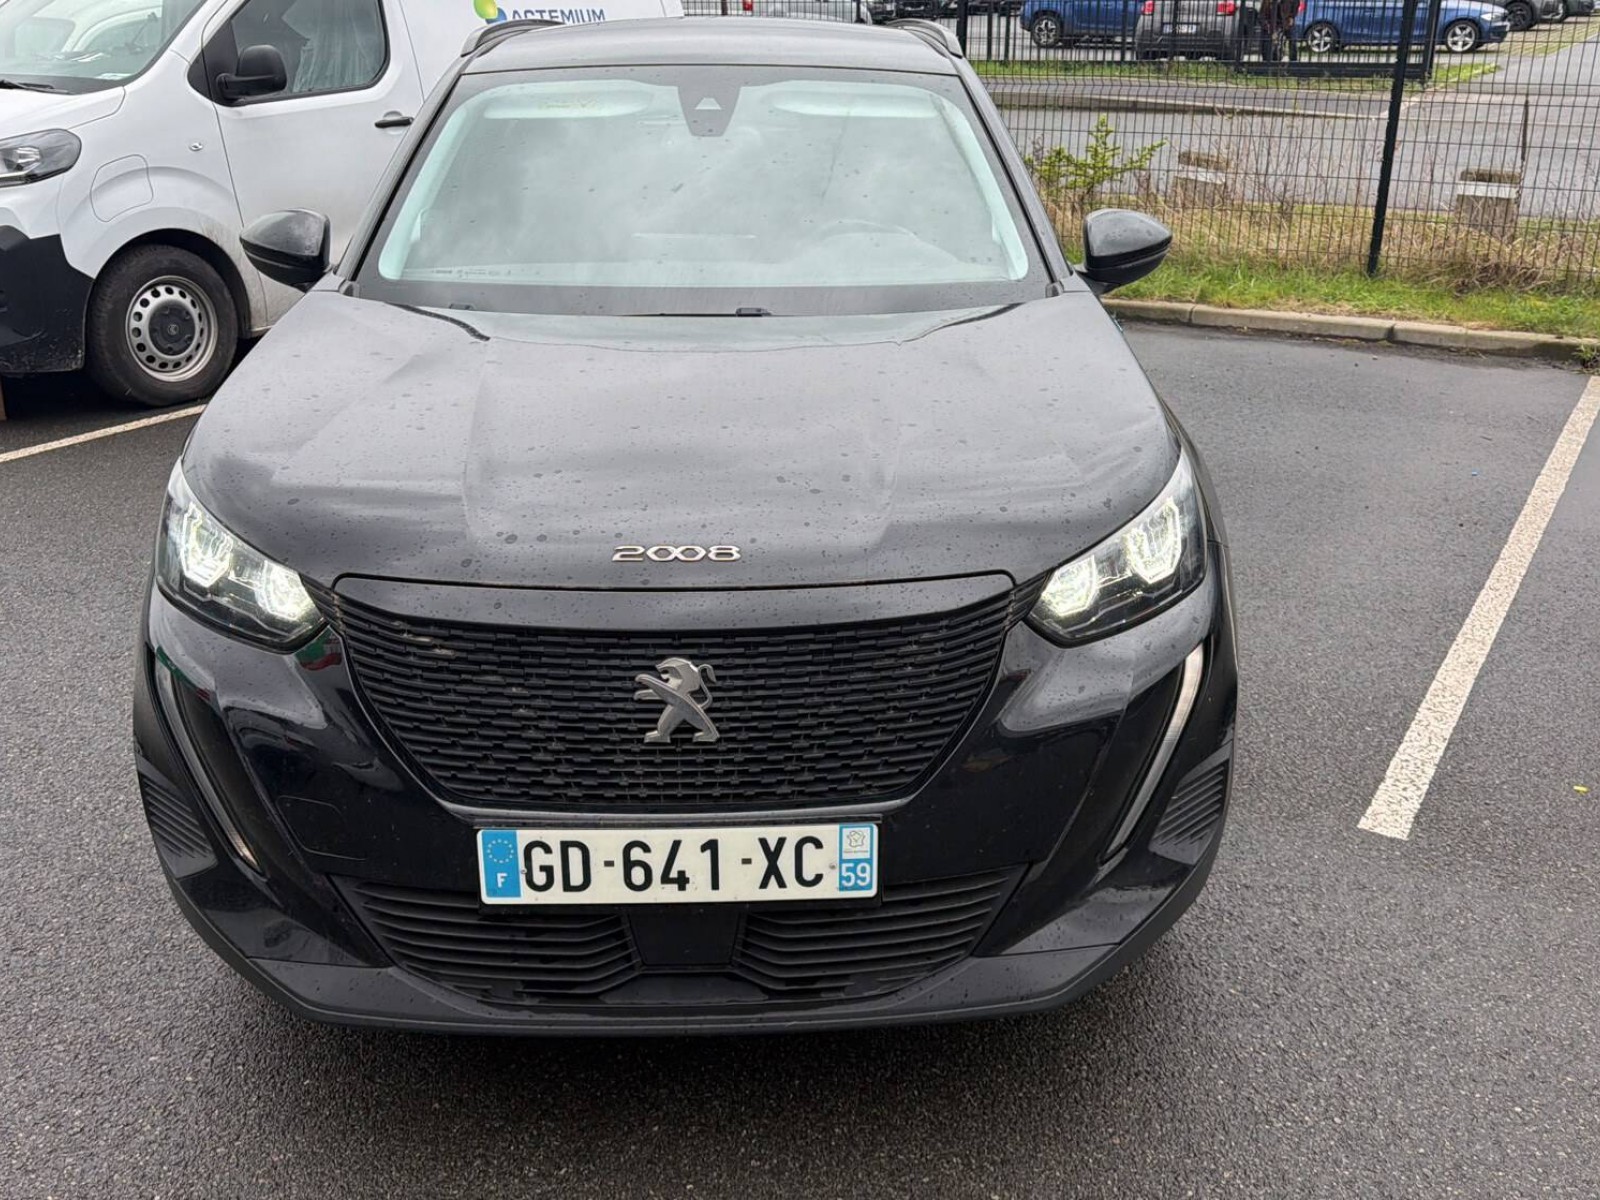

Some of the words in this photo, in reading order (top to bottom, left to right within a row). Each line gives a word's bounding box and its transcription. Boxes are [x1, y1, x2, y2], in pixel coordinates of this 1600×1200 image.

[611, 545, 742, 562] 2008
[523, 835, 824, 893] GD-641-XC
[841, 862, 871, 887] 59
[496, 872, 508, 888] F
